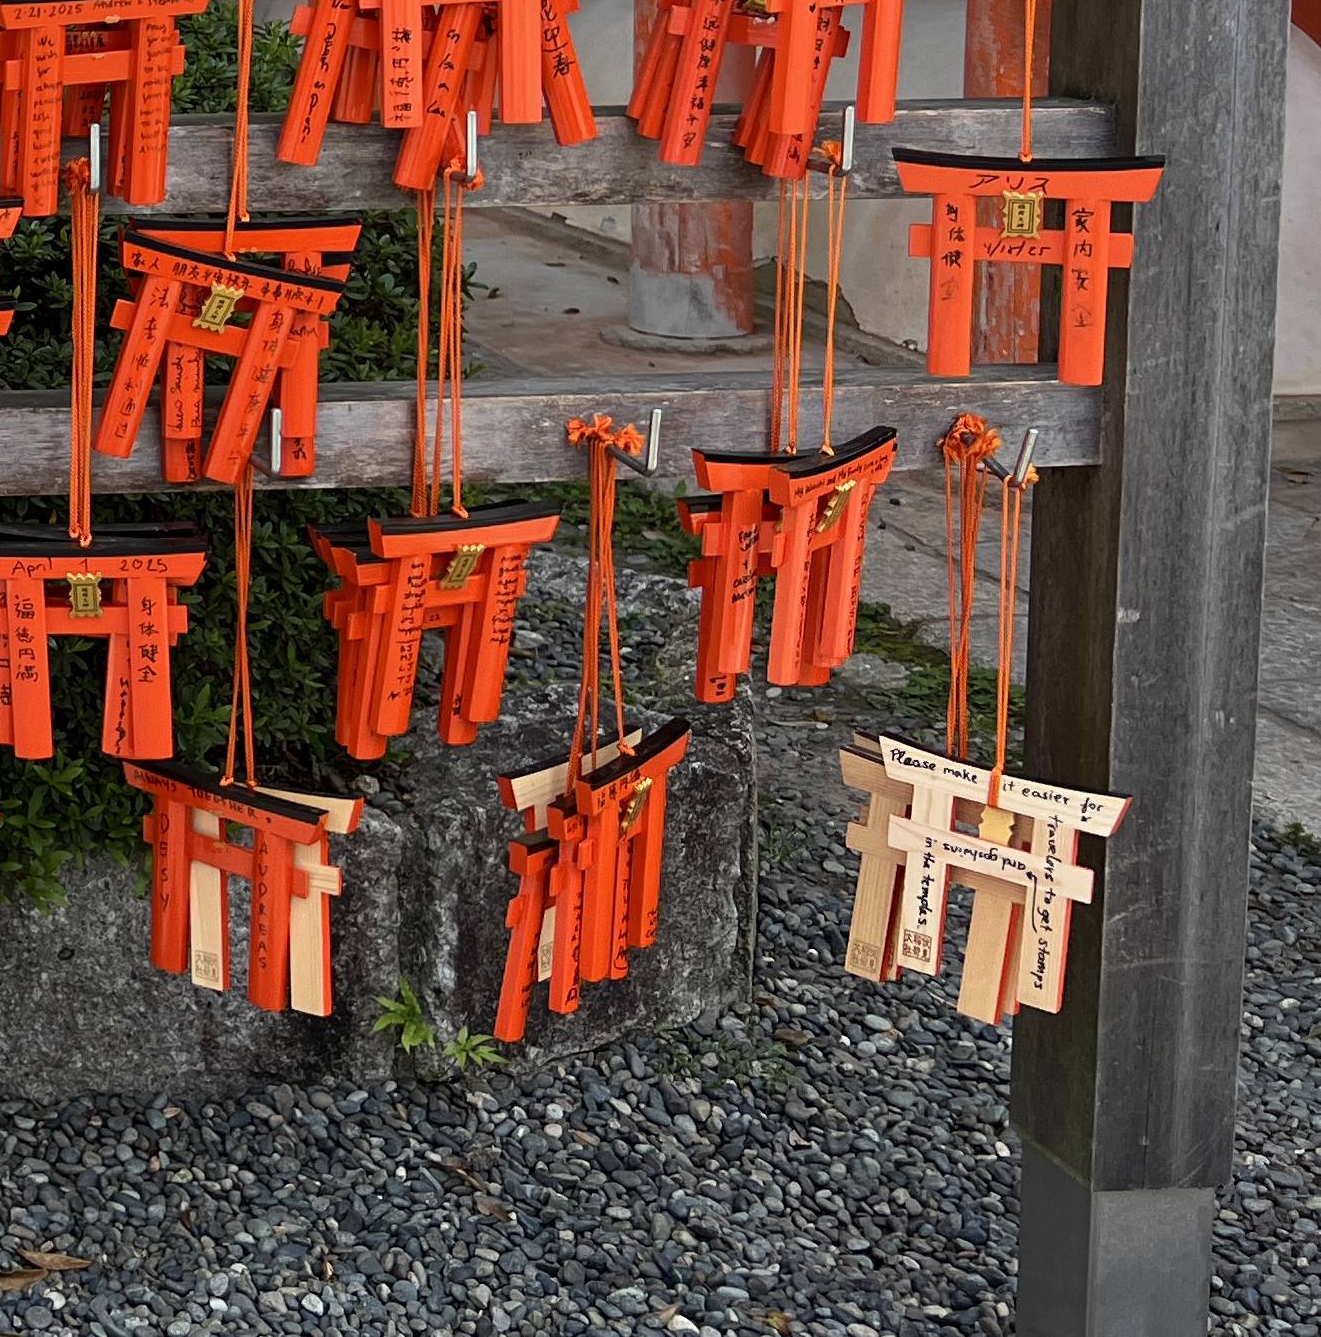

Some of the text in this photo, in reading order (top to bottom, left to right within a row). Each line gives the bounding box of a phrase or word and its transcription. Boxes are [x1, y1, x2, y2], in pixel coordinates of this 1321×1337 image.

[969, 174, 1049, 194] アリス
[12, 557, 53, 578] April
[119, 559, 168, 572] 2025
[891, 748, 1104, 814] Please make it easier for
[1037, 908, 1052, 931] get
[1033, 936, 1051, 990] stamps
